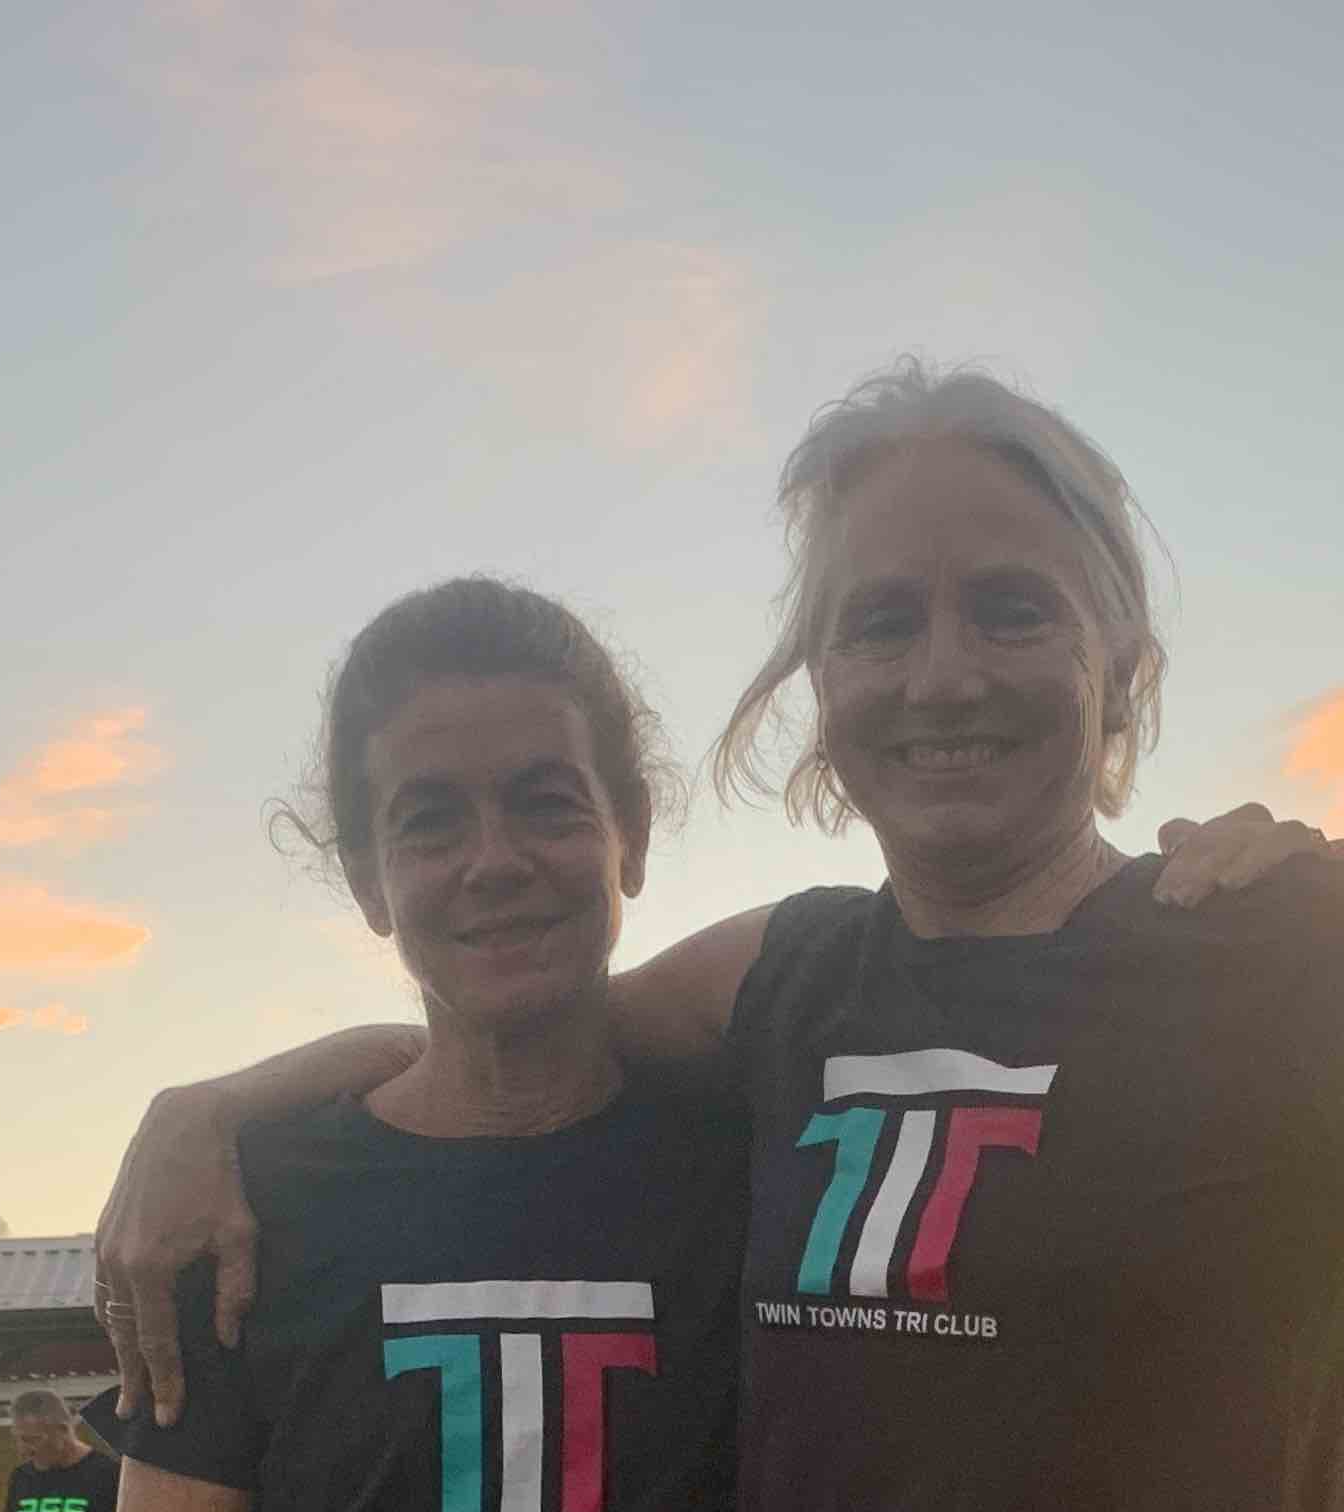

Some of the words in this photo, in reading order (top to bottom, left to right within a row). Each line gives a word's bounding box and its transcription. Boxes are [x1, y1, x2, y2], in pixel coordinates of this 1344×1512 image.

[756, 1302, 800, 1325] TWIN
[807, 1306, 887, 1330] TOWNS
[893, 1310, 928, 1333] TRI
[934, 1314, 998, 1337] CLUB
